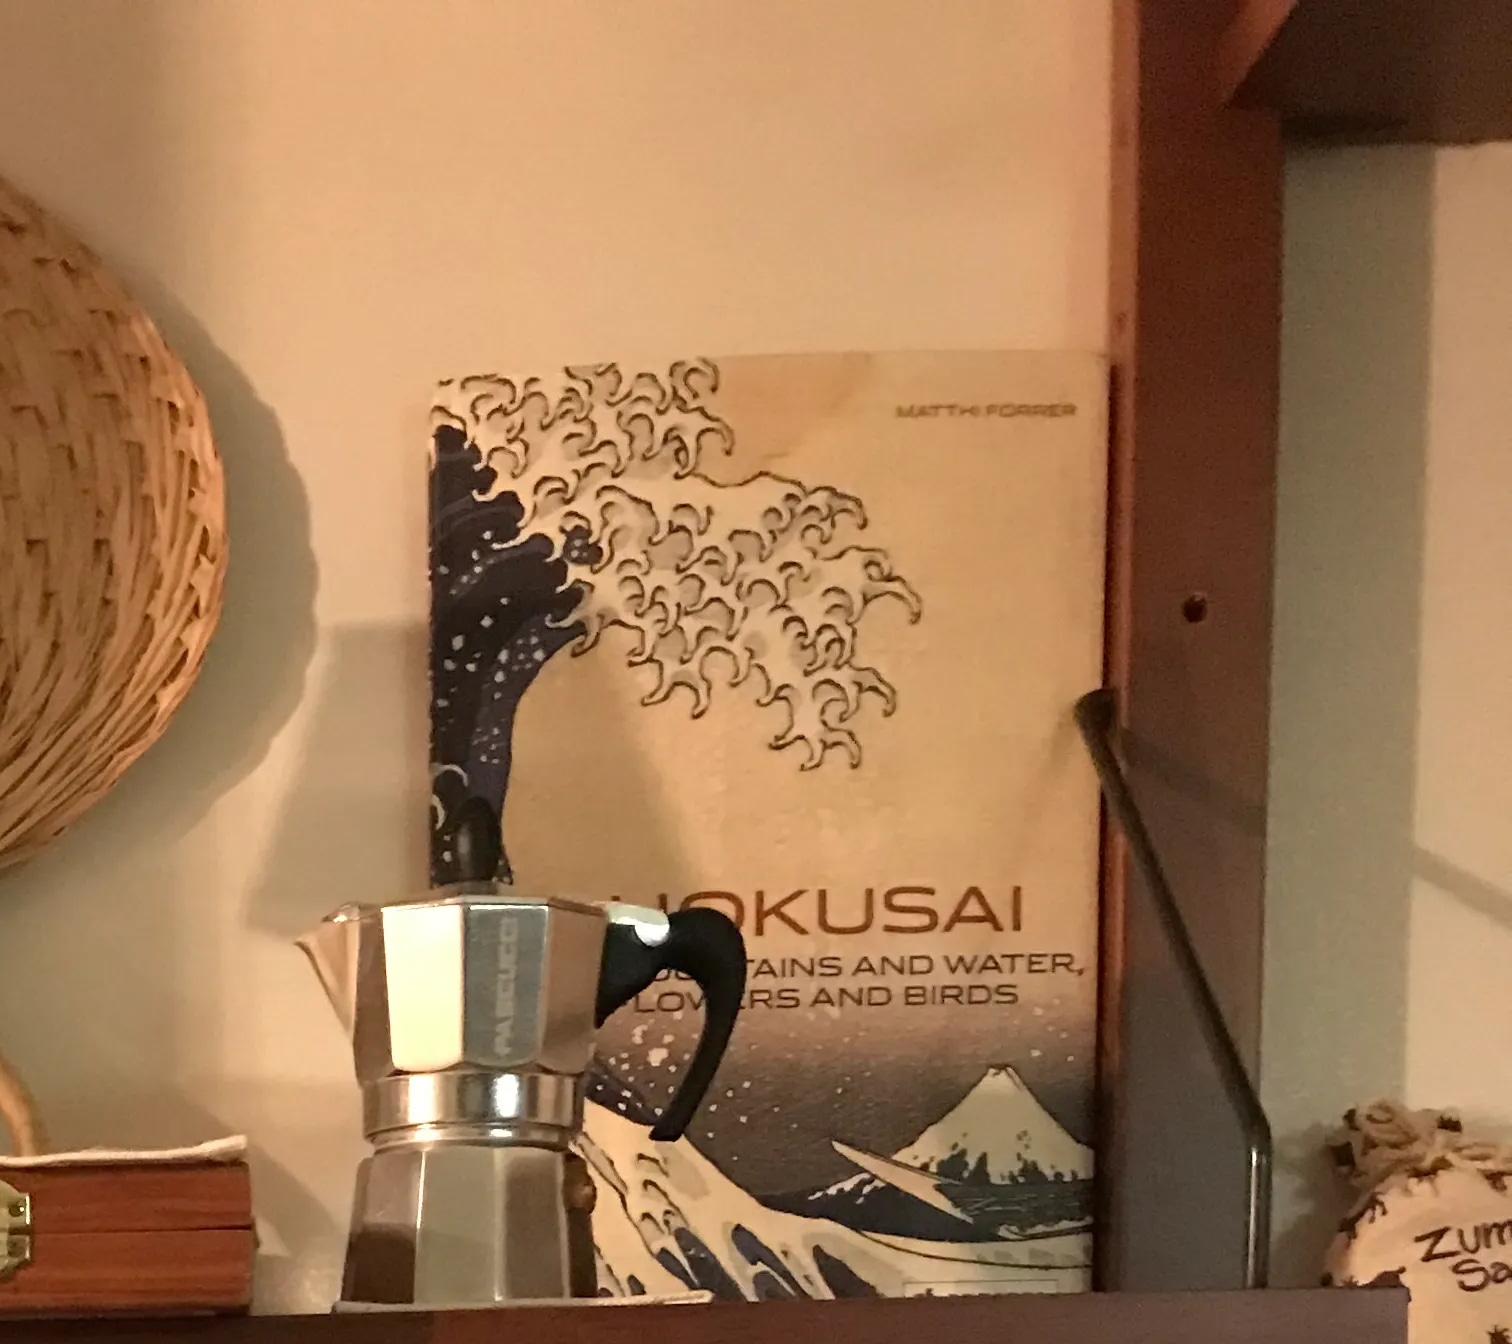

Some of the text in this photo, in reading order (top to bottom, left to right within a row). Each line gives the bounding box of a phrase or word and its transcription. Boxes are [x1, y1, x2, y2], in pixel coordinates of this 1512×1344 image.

[610, 885, 1023, 937] OKUSAI
[852, 957, 934, 978] AND
[943, 953, 1085, 977] WATER,
[806, 985, 892, 1008] AND
[904, 983, 1019, 1006] BIRDS
